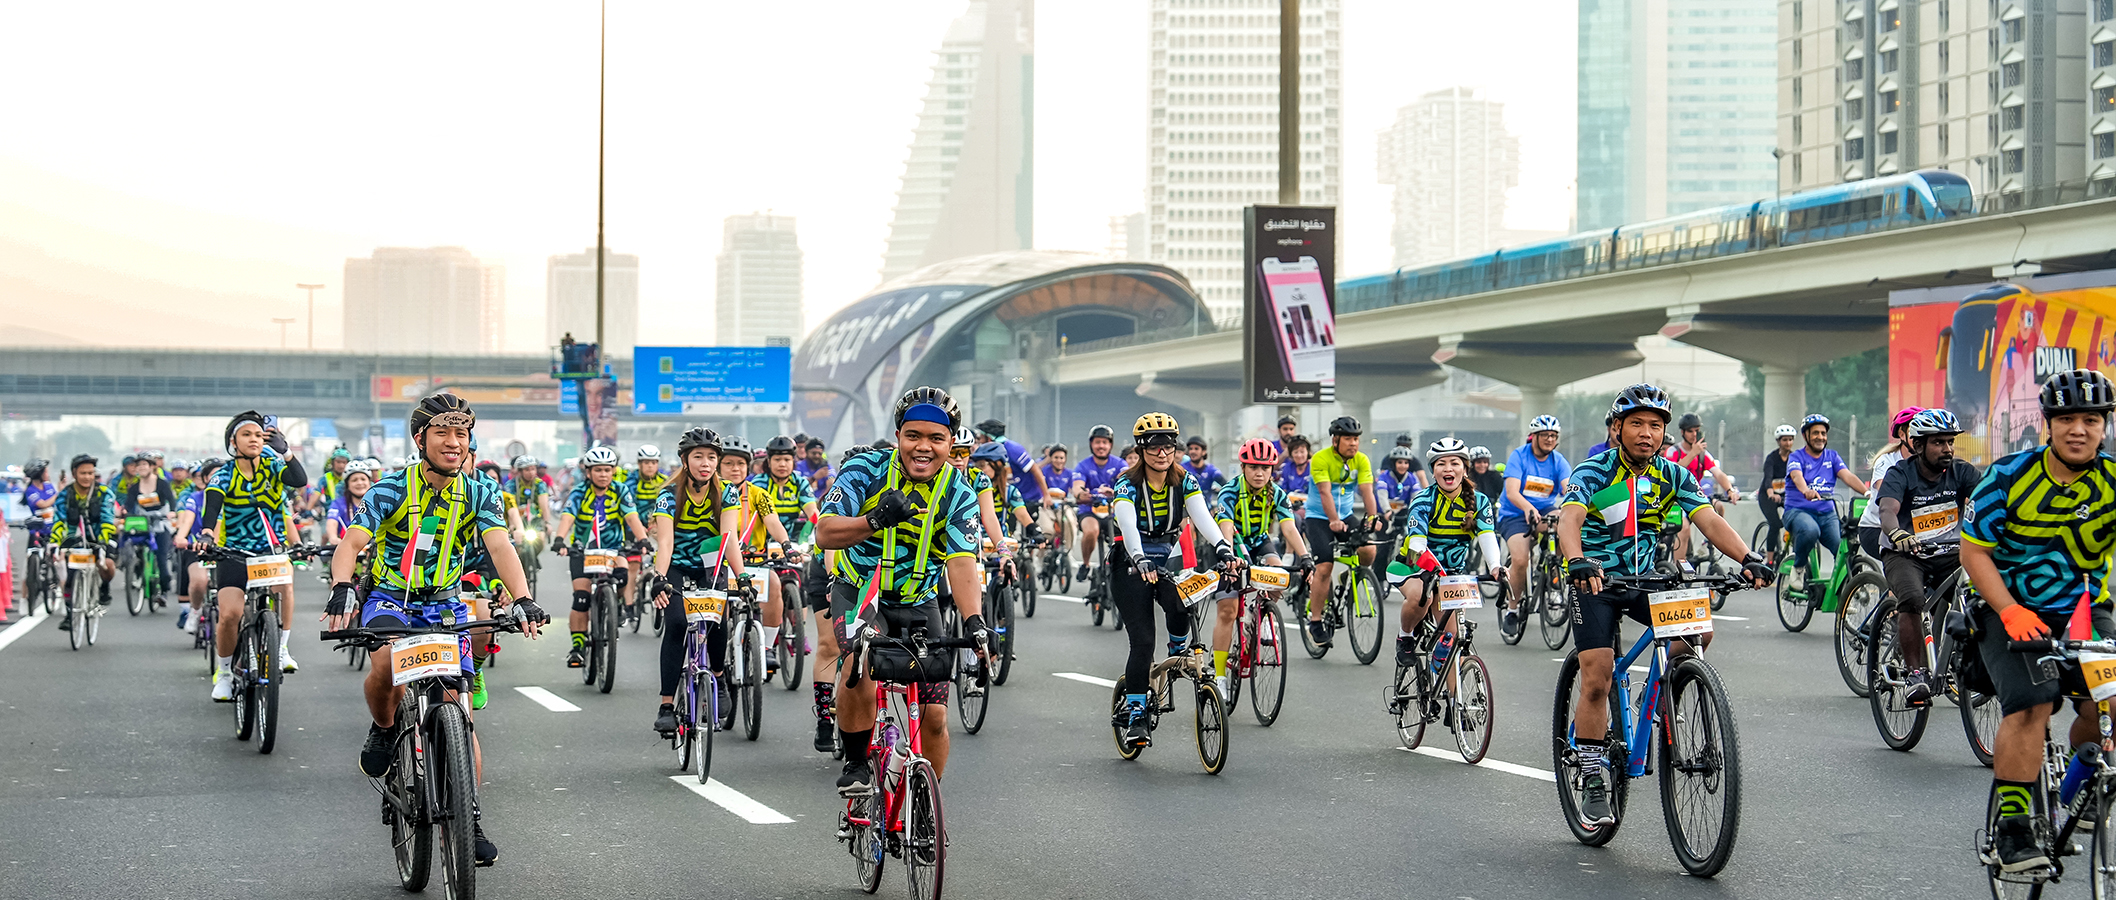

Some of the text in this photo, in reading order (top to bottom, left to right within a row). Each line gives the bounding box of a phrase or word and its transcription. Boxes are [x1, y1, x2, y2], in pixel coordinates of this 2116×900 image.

[2036, 346, 2074, 376] DUBAI
[1264, 386, 1315, 400] سيفورا
[1918, 517, 1946, 530] 04957
[253, 568, 278, 577] 18017
[1256, 573, 1278, 583] 18020
[1183, 577, 1208, 595] 22013
[1443, 589, 1469, 598] 02401
[1659, 609, 1693, 622] 04646
[400, 651, 438, 669] 23650
